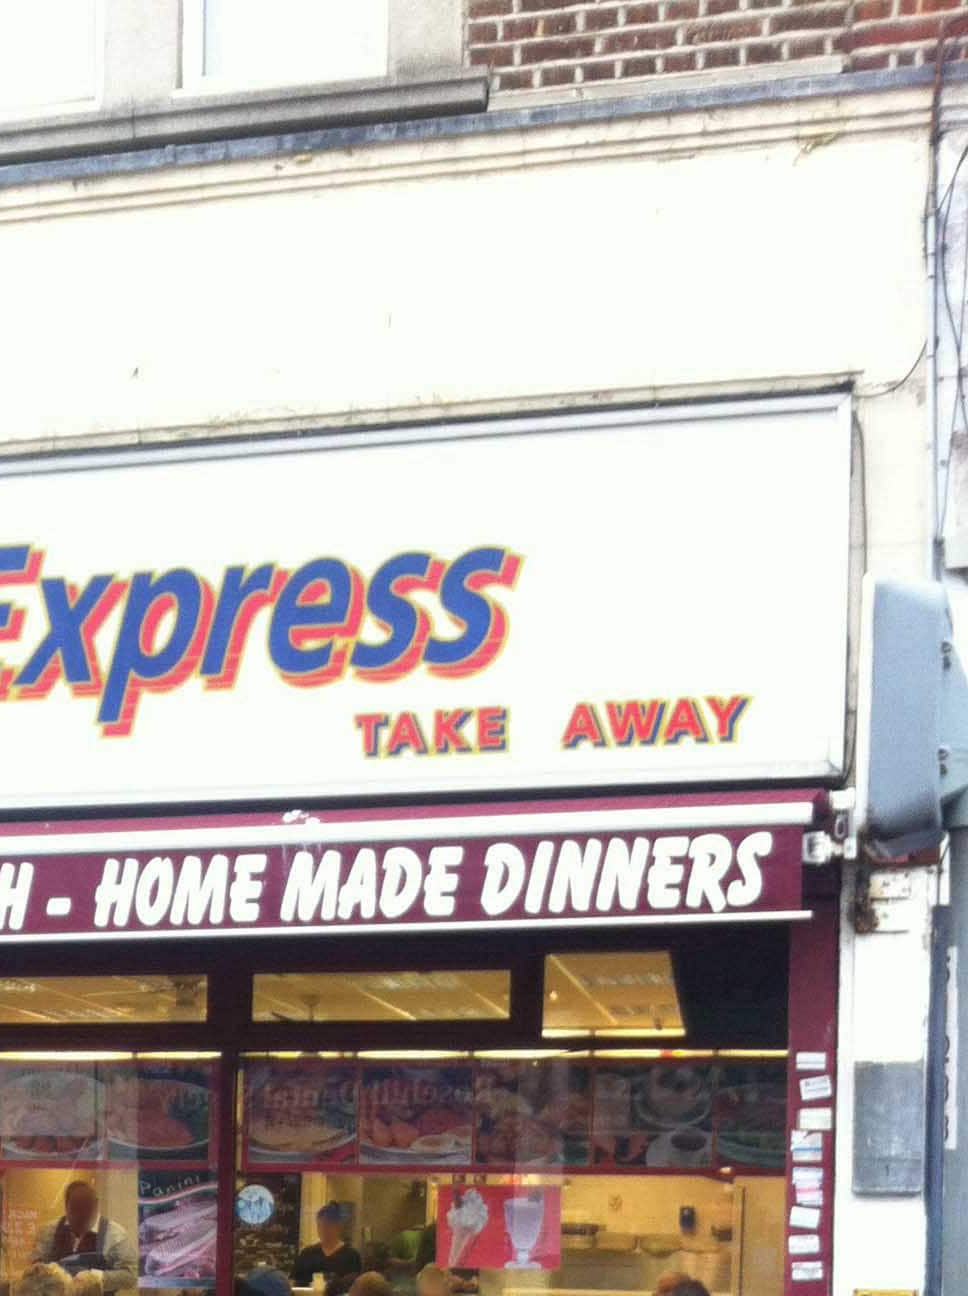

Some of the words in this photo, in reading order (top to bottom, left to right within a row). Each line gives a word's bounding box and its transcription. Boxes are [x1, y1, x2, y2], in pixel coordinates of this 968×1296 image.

[354, 705, 509, 758] TAKE
[560, 694, 752, 750] AWAY
[92, 854, 268, 930] HOME
[279, 844, 465, 923] MADE
[479, 831, 774, 914] DINNERS
[139, 1176, 201, 1197] Panini
